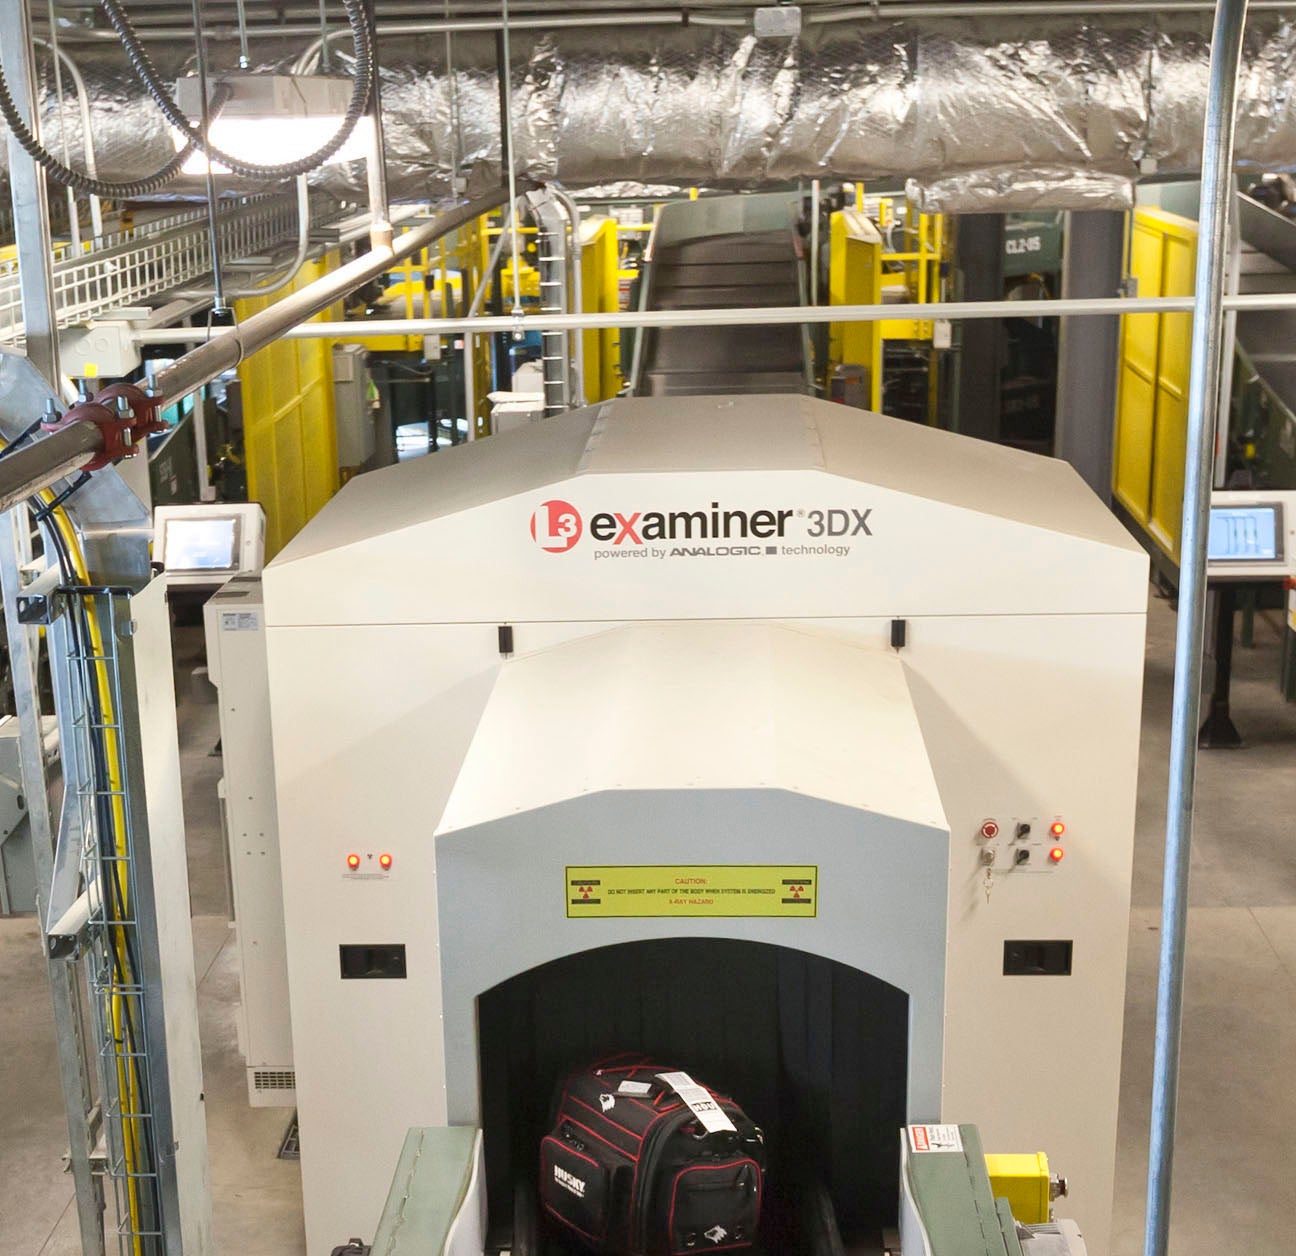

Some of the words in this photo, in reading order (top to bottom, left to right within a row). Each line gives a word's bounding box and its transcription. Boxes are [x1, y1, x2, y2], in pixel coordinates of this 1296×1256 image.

[533, 502, 581, 550] L3
[807, 508, 873, 537] 3DX
[594, 547, 648, 560] powered
[651, 547, 667, 560] by
[669, 545, 761, 557] ANALOGIC
[781, 544, 850, 557] technology
